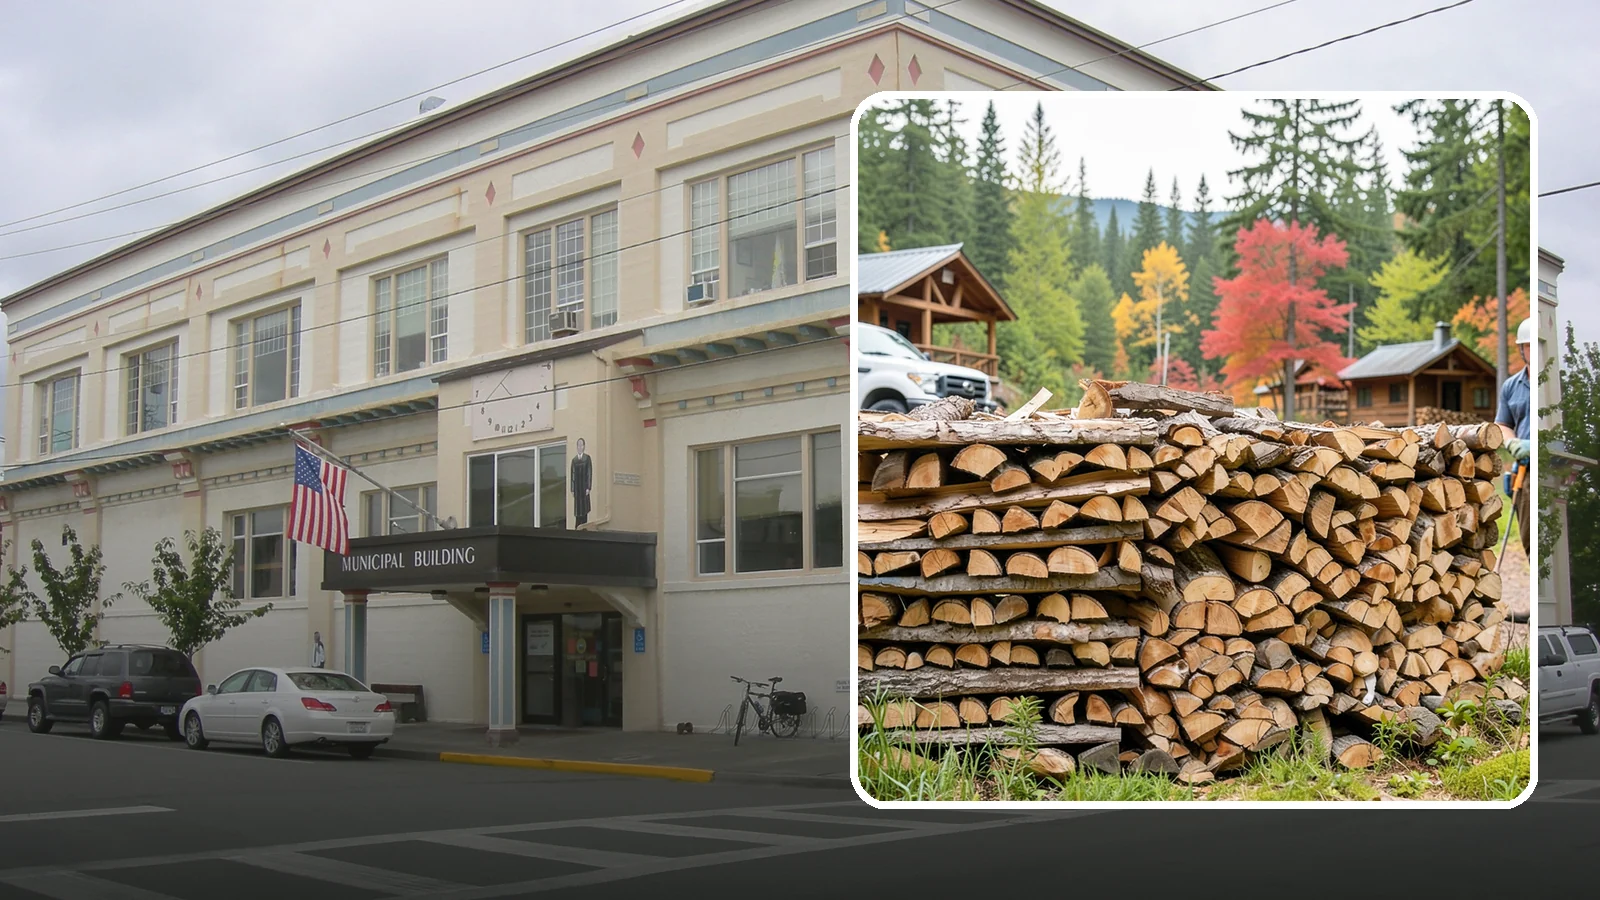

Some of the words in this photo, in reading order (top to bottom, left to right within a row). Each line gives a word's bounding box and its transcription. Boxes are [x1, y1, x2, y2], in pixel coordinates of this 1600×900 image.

[546, 362, 552, 370] 6
[488, 418, 492, 426] 9
[342, 552, 405, 572] MUNICIPAL
[414, 546, 475, 567] BUILDING
